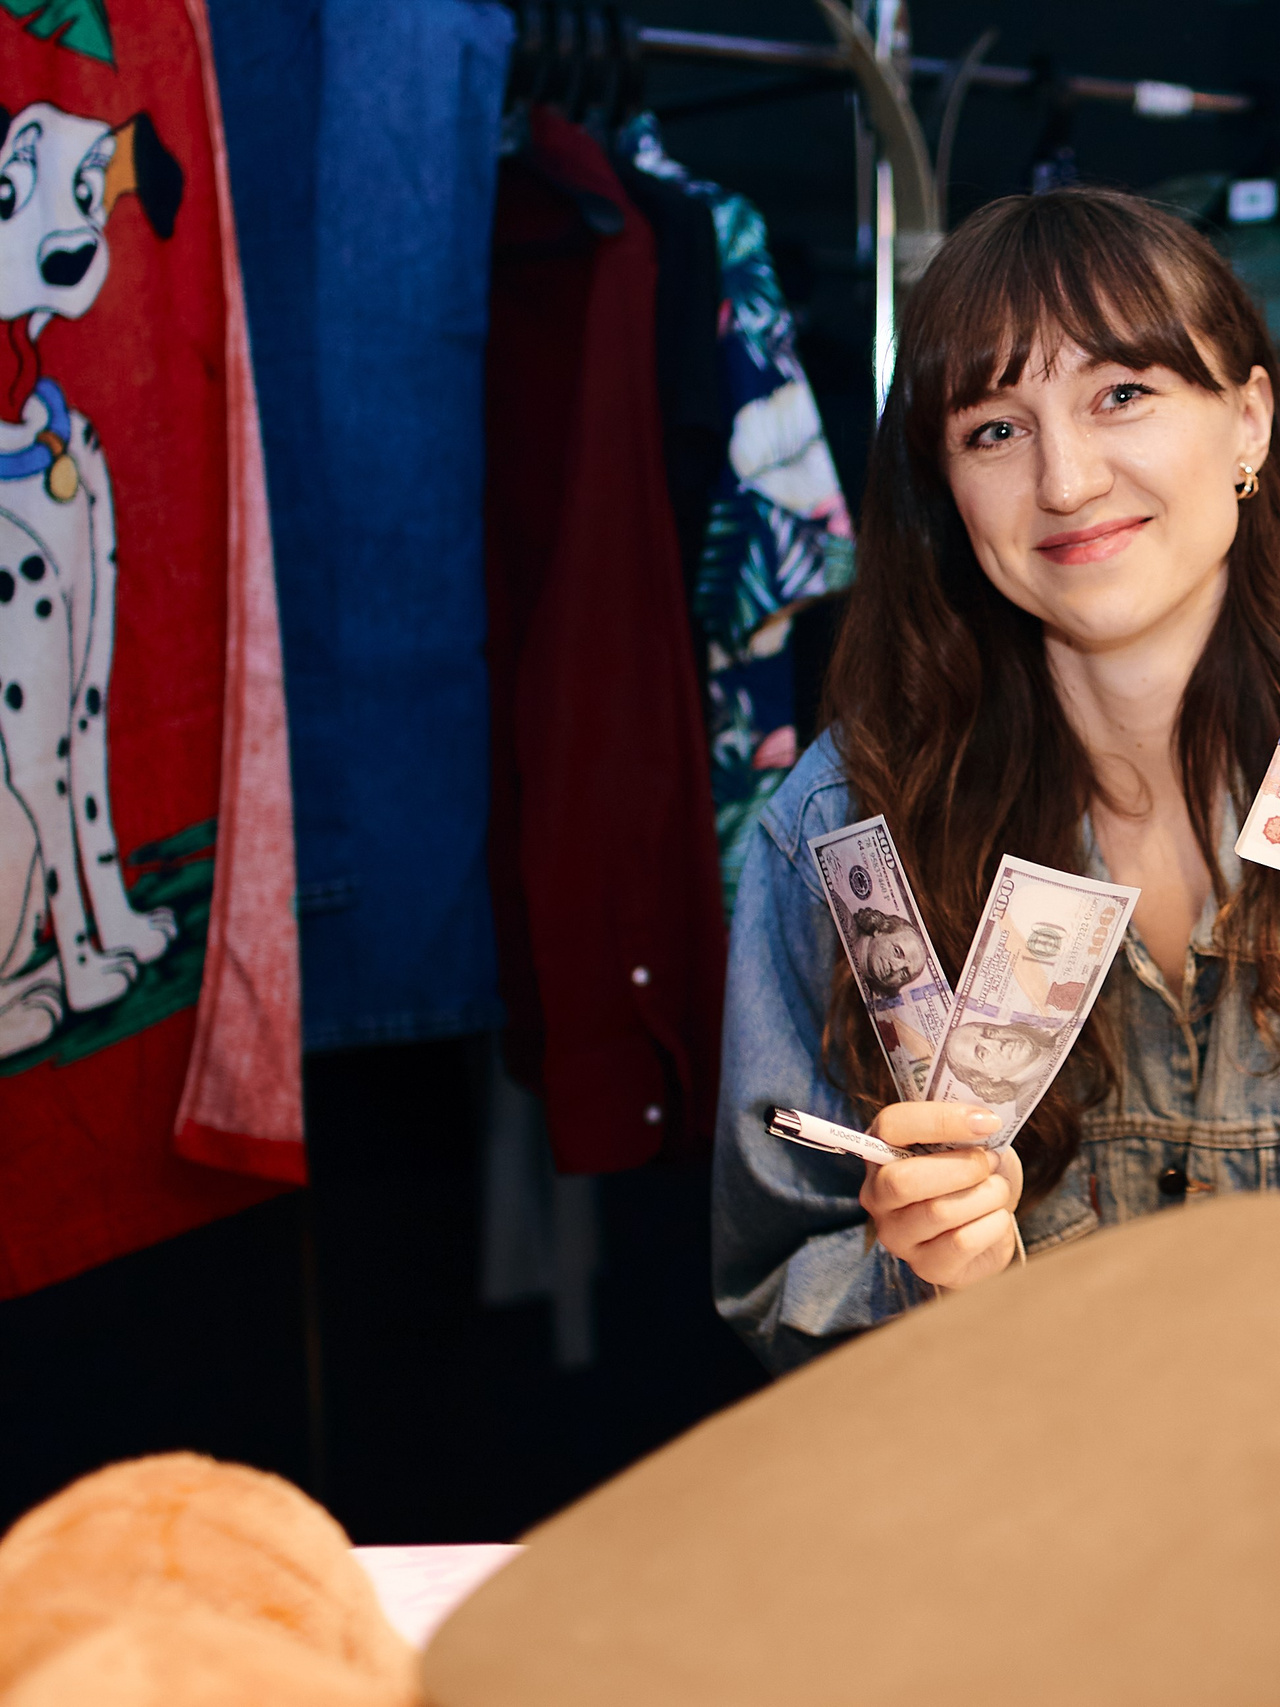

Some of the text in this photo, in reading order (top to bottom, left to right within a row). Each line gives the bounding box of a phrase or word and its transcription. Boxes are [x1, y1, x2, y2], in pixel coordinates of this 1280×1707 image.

[874, 828, 896, 870] 100
[991, 879, 1015, 919] 100
[1087, 906, 1116, 956] 100
[829, 1128, 861, 1143] ДОРОГИ
